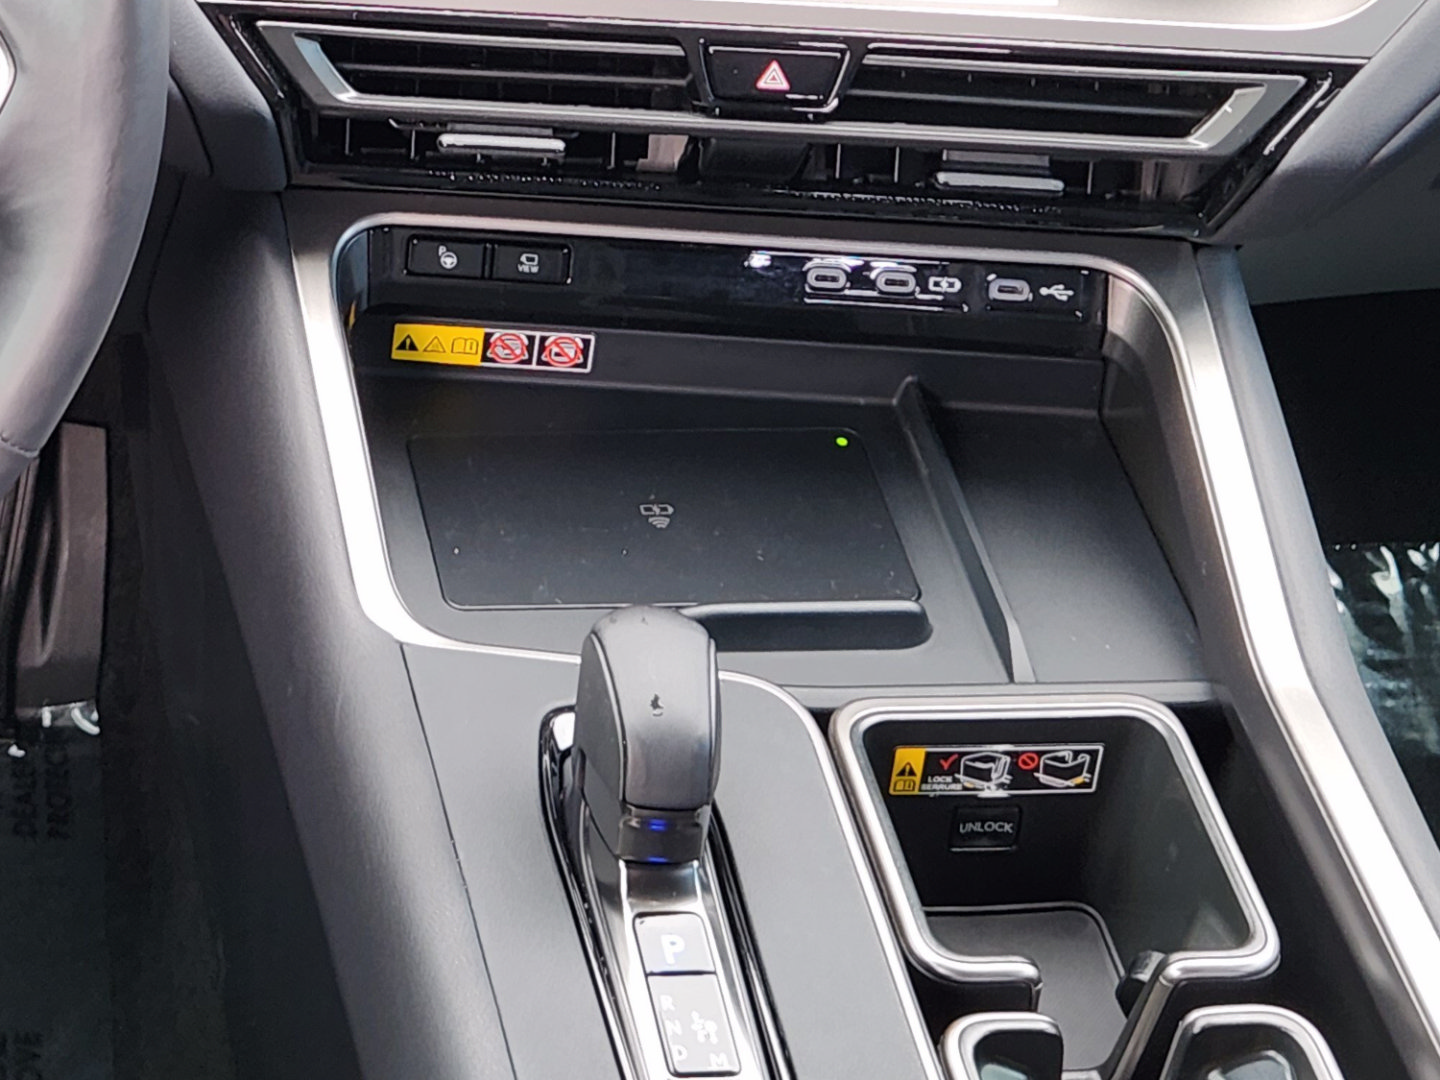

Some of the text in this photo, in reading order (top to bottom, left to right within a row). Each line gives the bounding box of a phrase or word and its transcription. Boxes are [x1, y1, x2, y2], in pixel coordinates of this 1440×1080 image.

[518, 264, 539, 273] VIEW
[959, 821, 1014, 834] UNLOCK
[661, 934, 685, 965] P
[660, 995, 676, 1011] R
